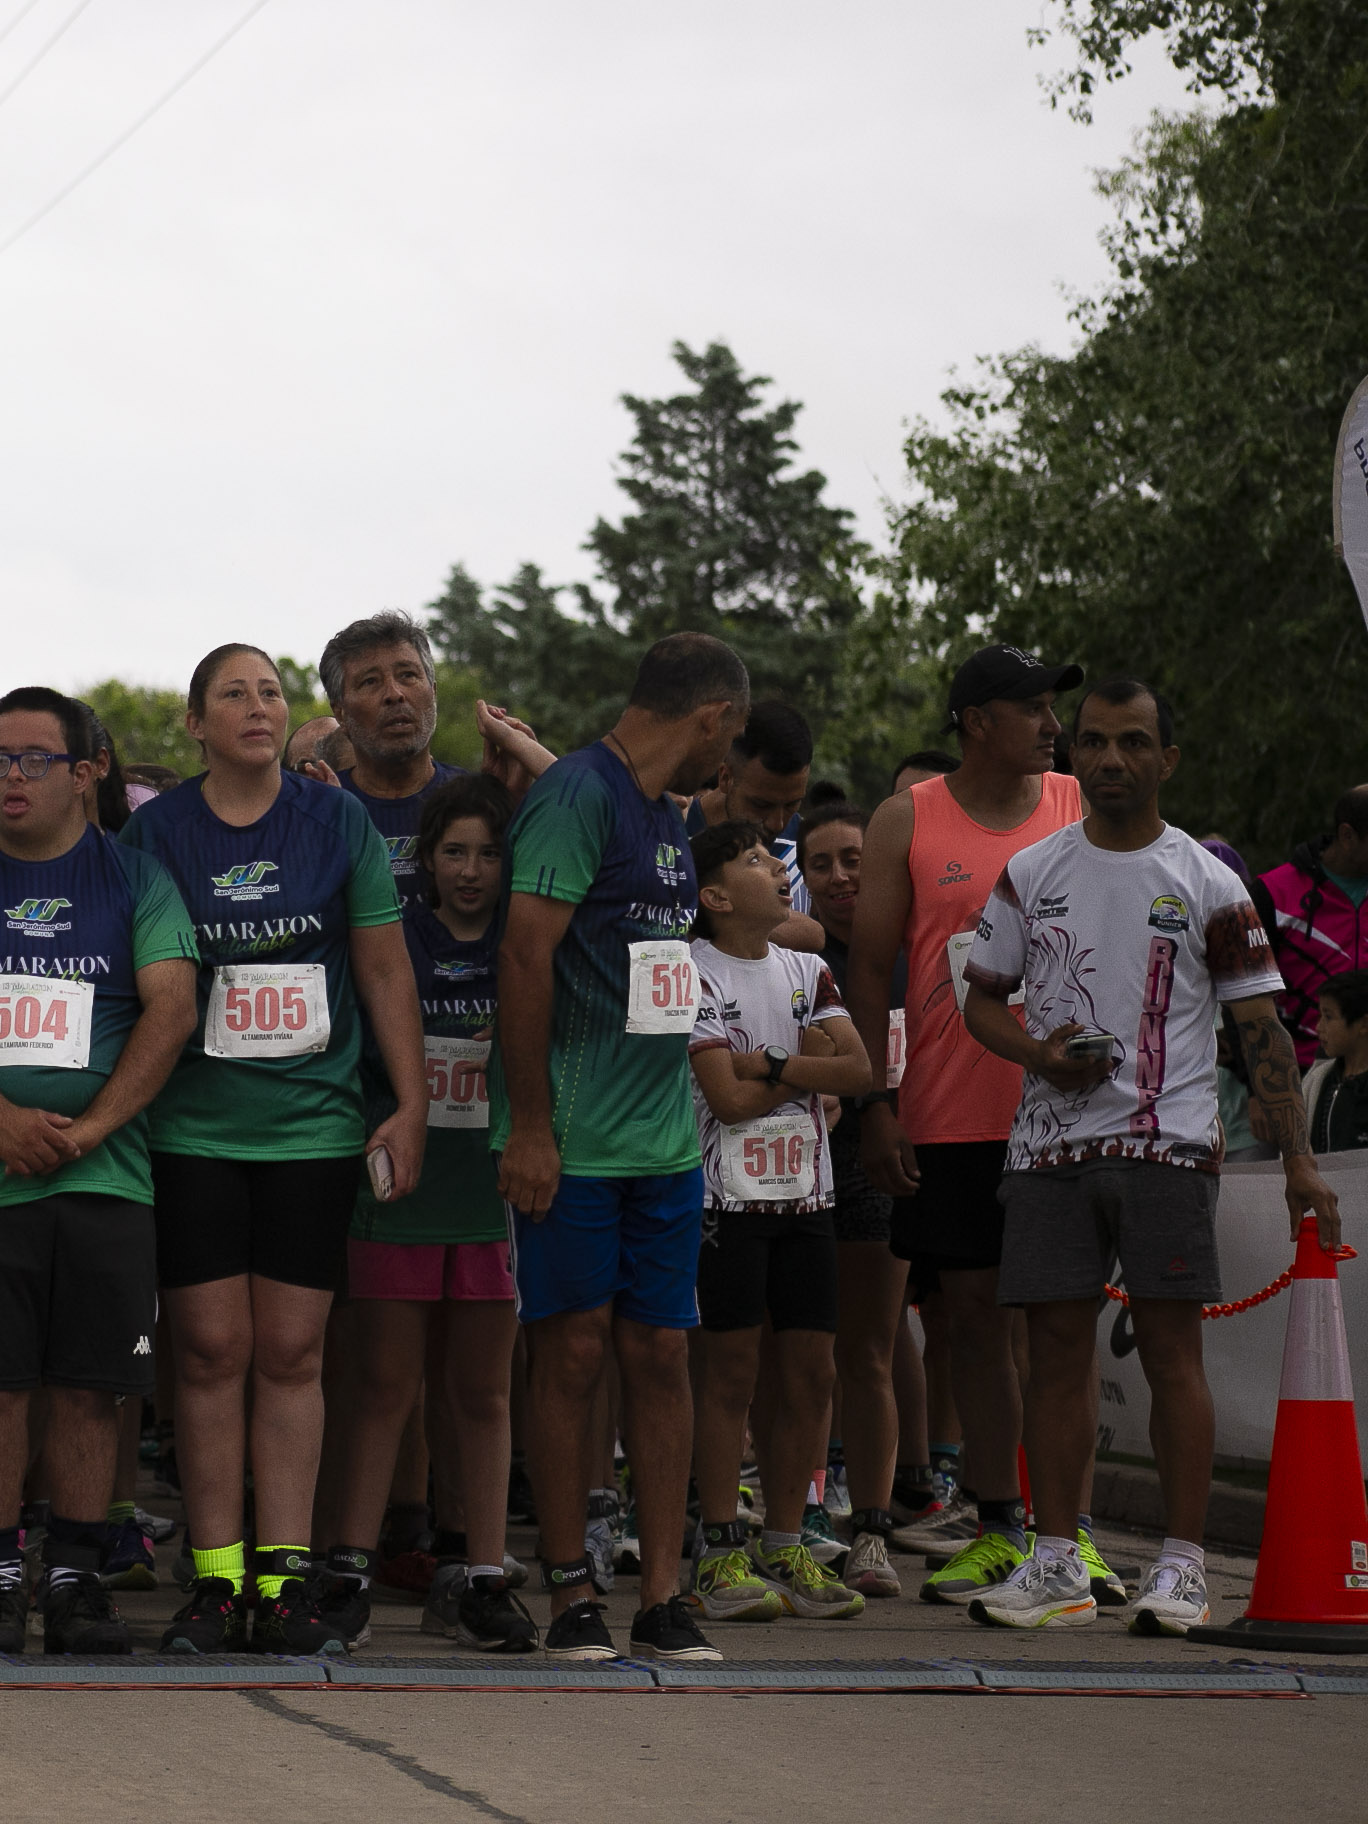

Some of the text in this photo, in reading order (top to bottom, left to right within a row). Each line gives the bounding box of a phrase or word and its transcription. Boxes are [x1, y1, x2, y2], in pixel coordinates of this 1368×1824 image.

[214, 888, 229, 896] San
[264, 884, 280, 893] Sud
[7, 921, 22, 929] San
[57, 921, 71, 930] Sud
[1157, 919, 1181, 929] RUNNER
[652, 963, 694, 1008] 512
[225, 986, 308, 1032] 505
[695, 1007, 717, 1022] OS
[30, 1041, 54, 1049] FEDERICO
[744, 1135, 804, 1177] 516
